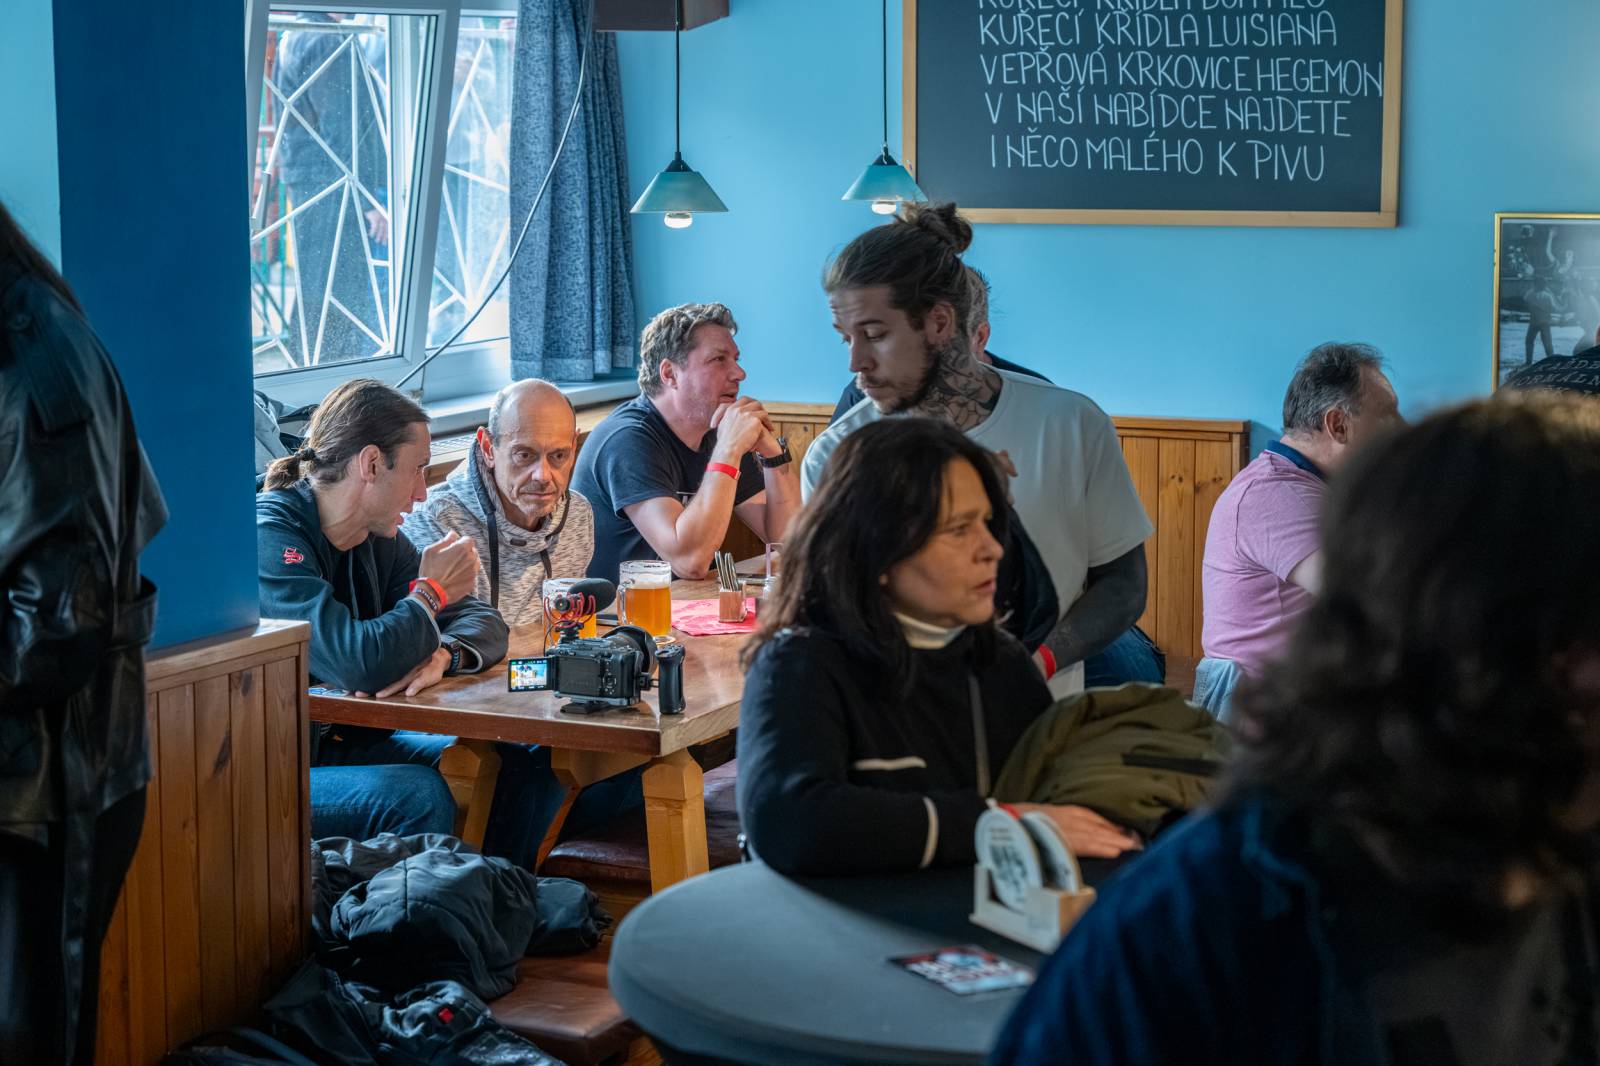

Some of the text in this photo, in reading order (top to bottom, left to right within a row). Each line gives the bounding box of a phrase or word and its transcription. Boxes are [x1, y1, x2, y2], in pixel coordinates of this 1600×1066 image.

[979, 8, 1337, 48] KUŘECÍ KŘÍDLA LUISIANA
[979, 44, 1383, 97] VEPŘOVÁ KRKOVICE HEGEMON
[985, 85, 1352, 137] V NAŠÍ NABÍDCE NAJDETE
[990, 127, 1325, 182] I NĚCO MALÉHO K PIVU
